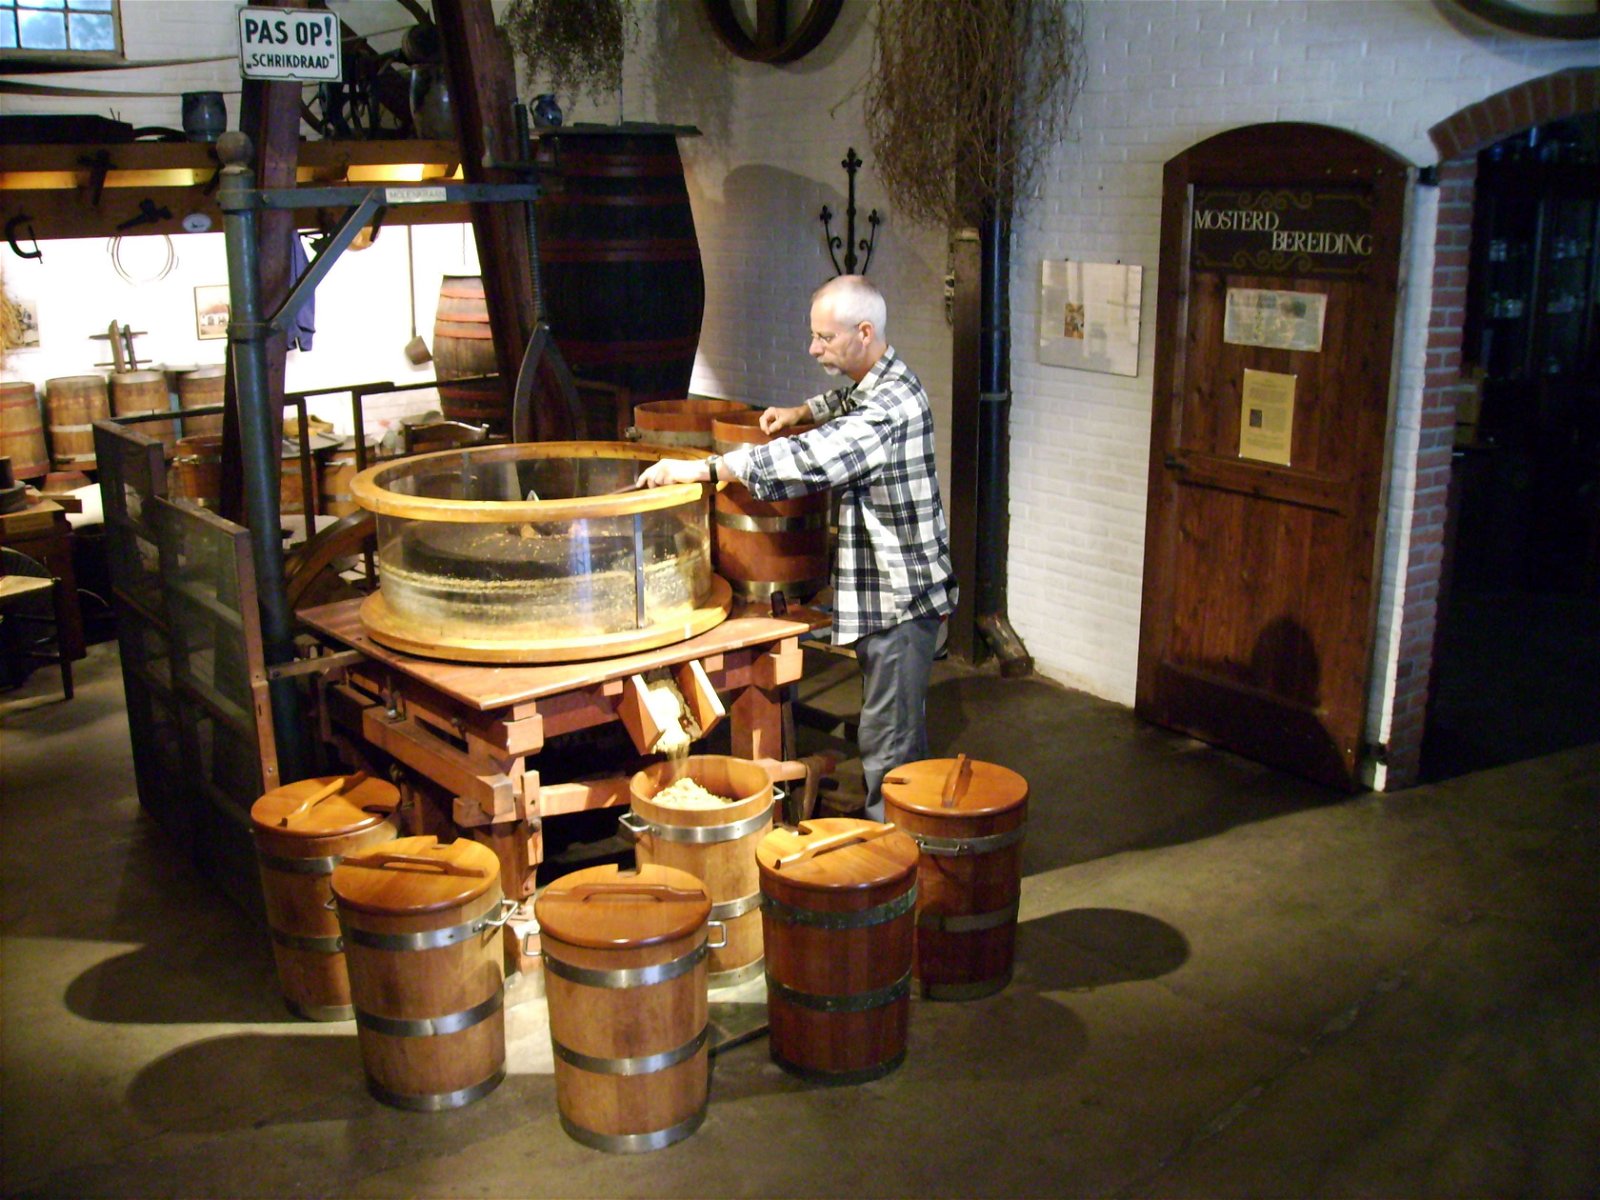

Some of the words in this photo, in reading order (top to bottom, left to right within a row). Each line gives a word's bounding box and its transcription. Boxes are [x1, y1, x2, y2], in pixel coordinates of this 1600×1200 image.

[245, 18, 288, 44] PAS
[296, 16, 332, 46] OP!
[1194, 209, 1279, 232] MOSTERD
[1272, 230, 1373, 256] BEREIDING
